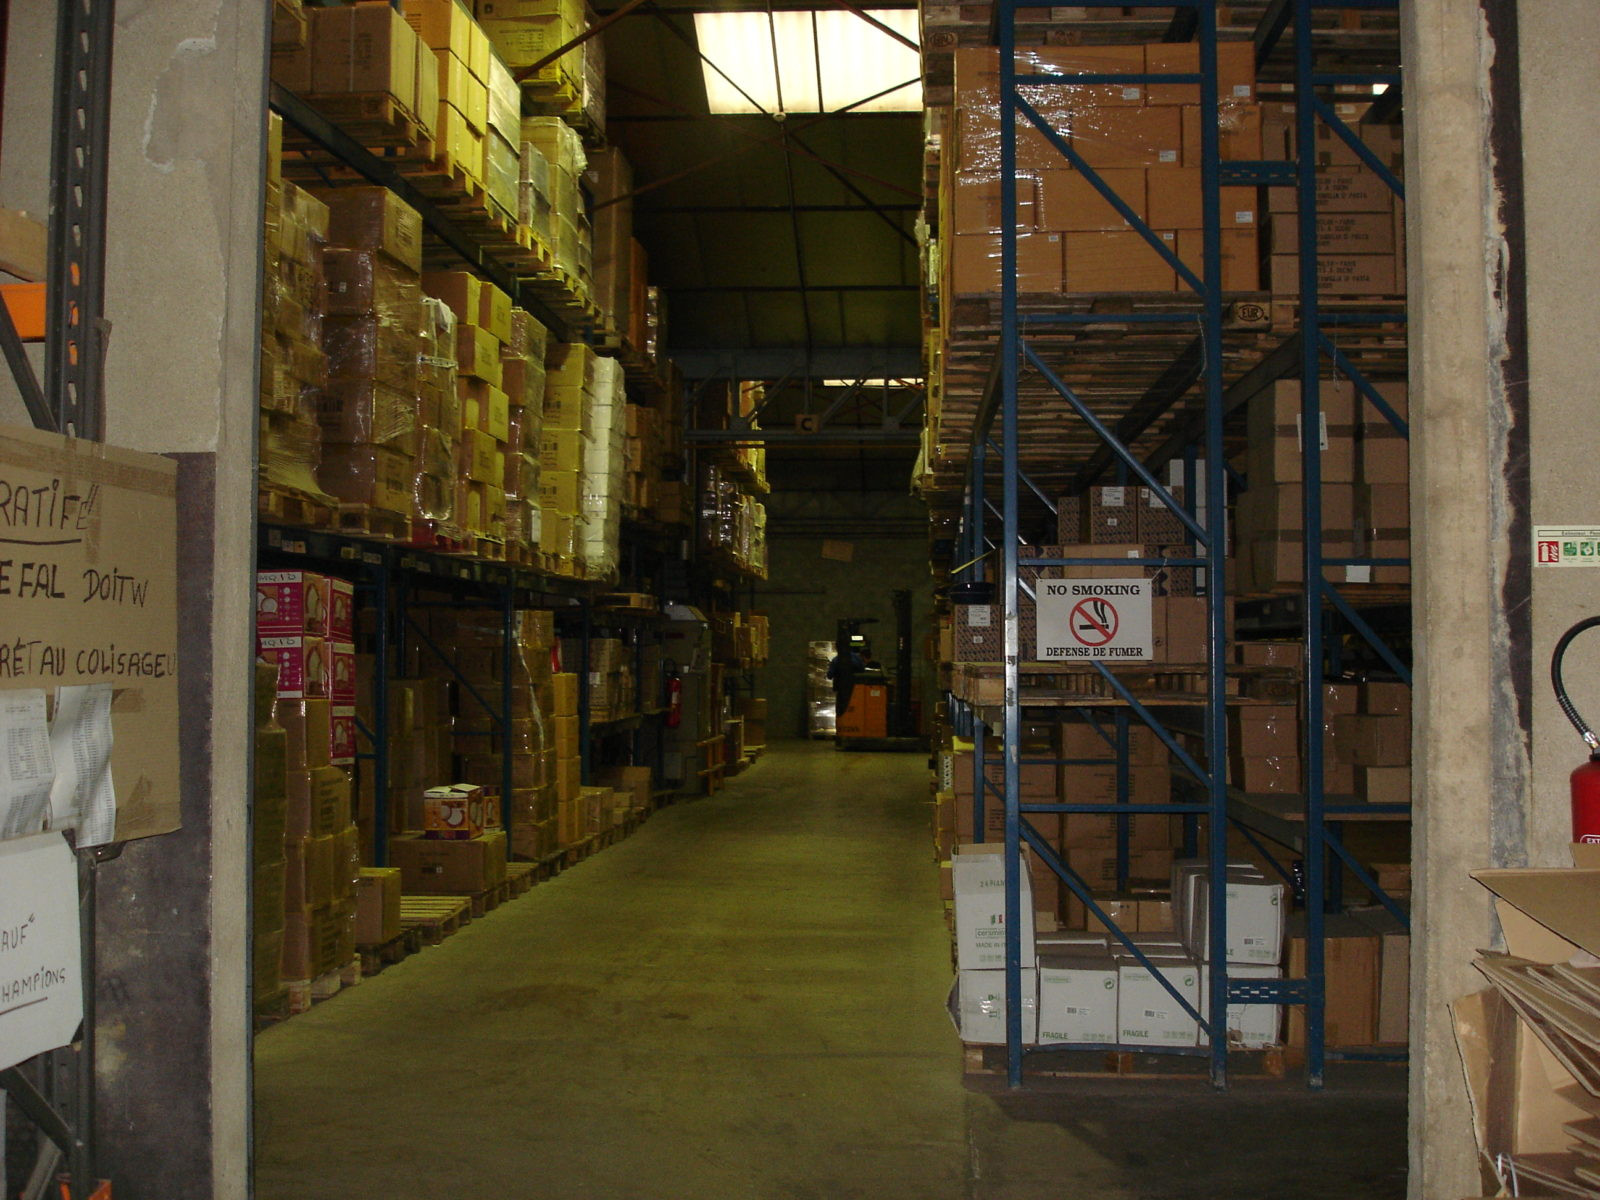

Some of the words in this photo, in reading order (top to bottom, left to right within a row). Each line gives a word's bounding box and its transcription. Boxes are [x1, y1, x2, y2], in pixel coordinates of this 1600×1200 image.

[1047, 585, 1067, 596] NO
[1072, 585, 1140, 596] SMOKING
[1046, 647, 1091, 657] DEFENSE
[1093, 647, 1107, 657] DE
[1109, 647, 1143, 657] FUMER
[39, 645, 65, 676] AU
[1042, 1031, 1069, 1040] FRAGILE
[1122, 1029, 1149, 1038] FRAGILE
